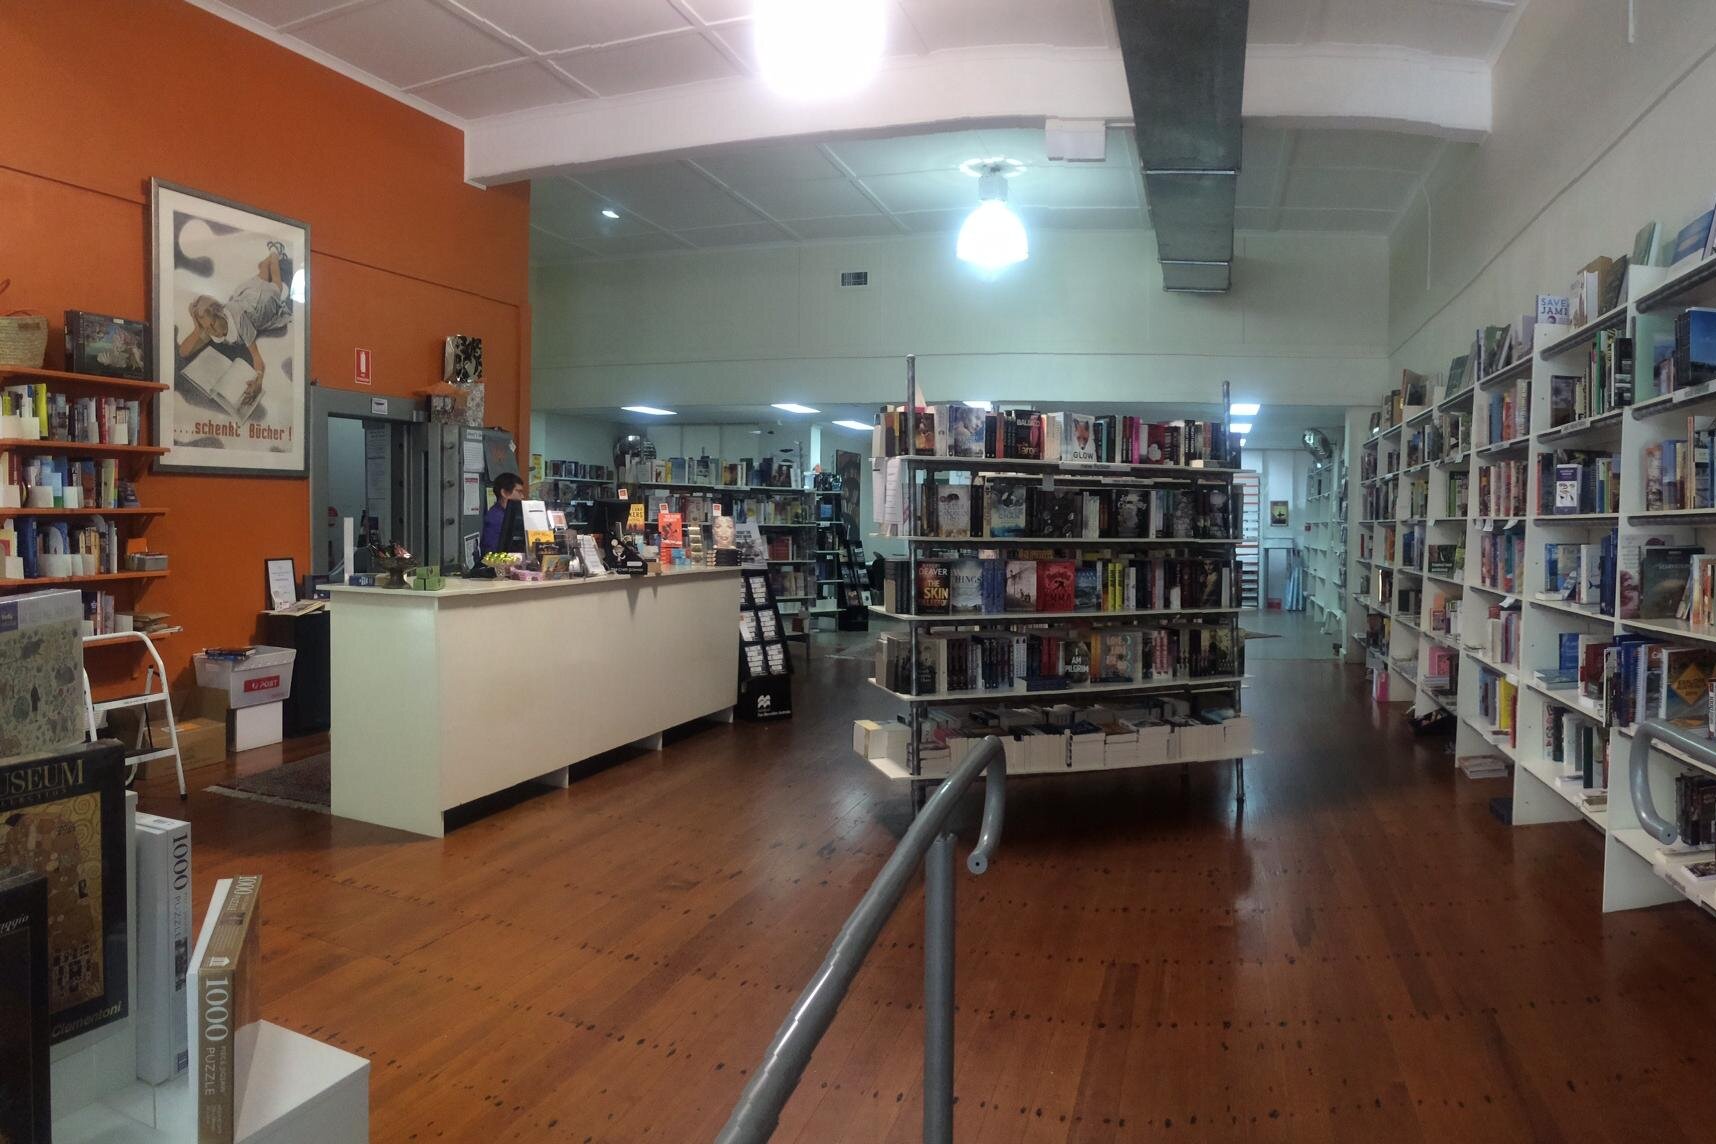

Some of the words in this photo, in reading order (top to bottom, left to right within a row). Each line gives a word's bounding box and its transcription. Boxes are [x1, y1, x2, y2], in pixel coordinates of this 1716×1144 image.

[1073, 451, 1094, 460] GLOW
[923, 587, 949, 600] SKIN
[927, 579, 941, 588] THE
[1064, 664, 1089, 673] PILGRIM
[173, 834, 188, 891] 1000
[52, 999, 122, 1038] Clementoni
[204, 976, 229, 1042] 1000
[204, 1047, 216, 1096] PUZZLE
